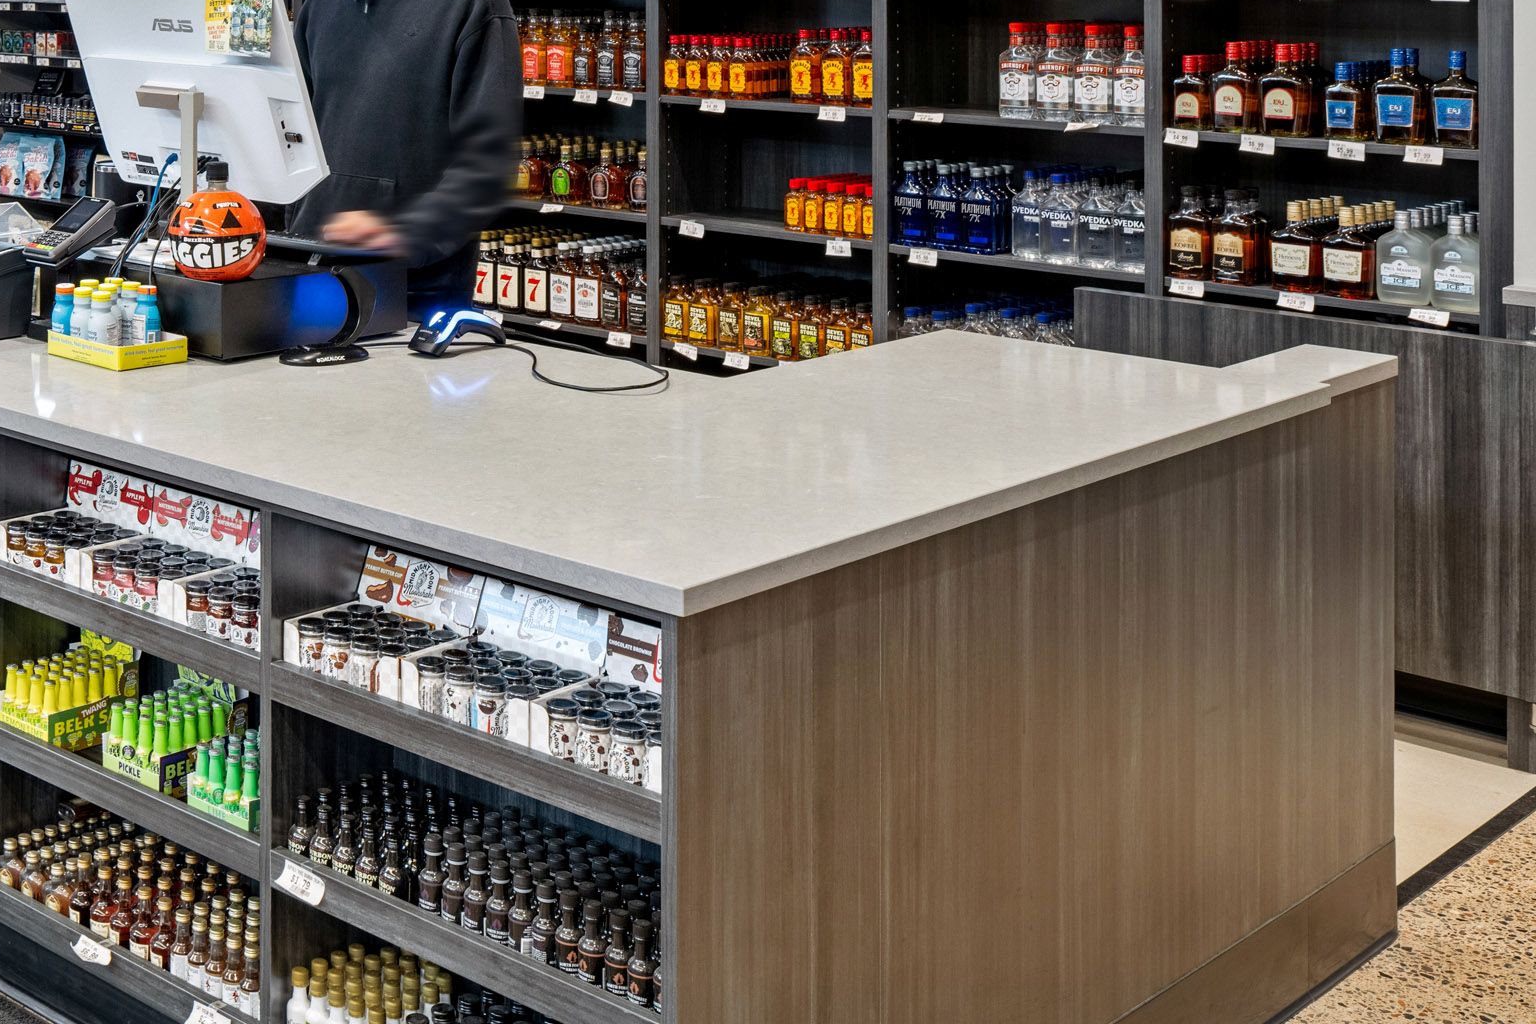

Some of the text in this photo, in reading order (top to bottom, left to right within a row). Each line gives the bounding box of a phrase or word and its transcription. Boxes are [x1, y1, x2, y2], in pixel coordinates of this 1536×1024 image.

[152, 18, 193, 33] ASUS
[1038, 63, 1065, 71] SMIRNOFF
[1115, 67, 1144, 75] SMIRNOFF
[894, 197, 922, 209] PLATINUM
[927, 199, 956, 212] PLATINUM
[901, 207, 912, 216] 7X
[935, 210, 946, 219] 7X
[961, 203, 990, 216] PLATINUM
[1012, 206, 1039, 215] SVEDKA
[969, 214, 980, 223] 7X
[1041, 211, 1071, 221] SVEDKA
[1080, 215, 1110, 225] SVEDKA
[1113, 218, 1145, 228] SVEDKA
[475, 270, 488, 294] 7
[500, 274, 513, 298] 7
[527, 278, 541, 302] 7
[74, 477, 86, 485] APPLE
[126, 492, 139, 500] APPLE
[409, 563, 431, 587] MIDNIGHT
[608, 638, 653, 657] CHOCOLATE BROWNIE
[81, 701, 107, 718] TWANG
[54, 715, 95, 737] BEER
[118, 761, 141, 779] PICKLE
[165, 759, 196, 780] BEE
